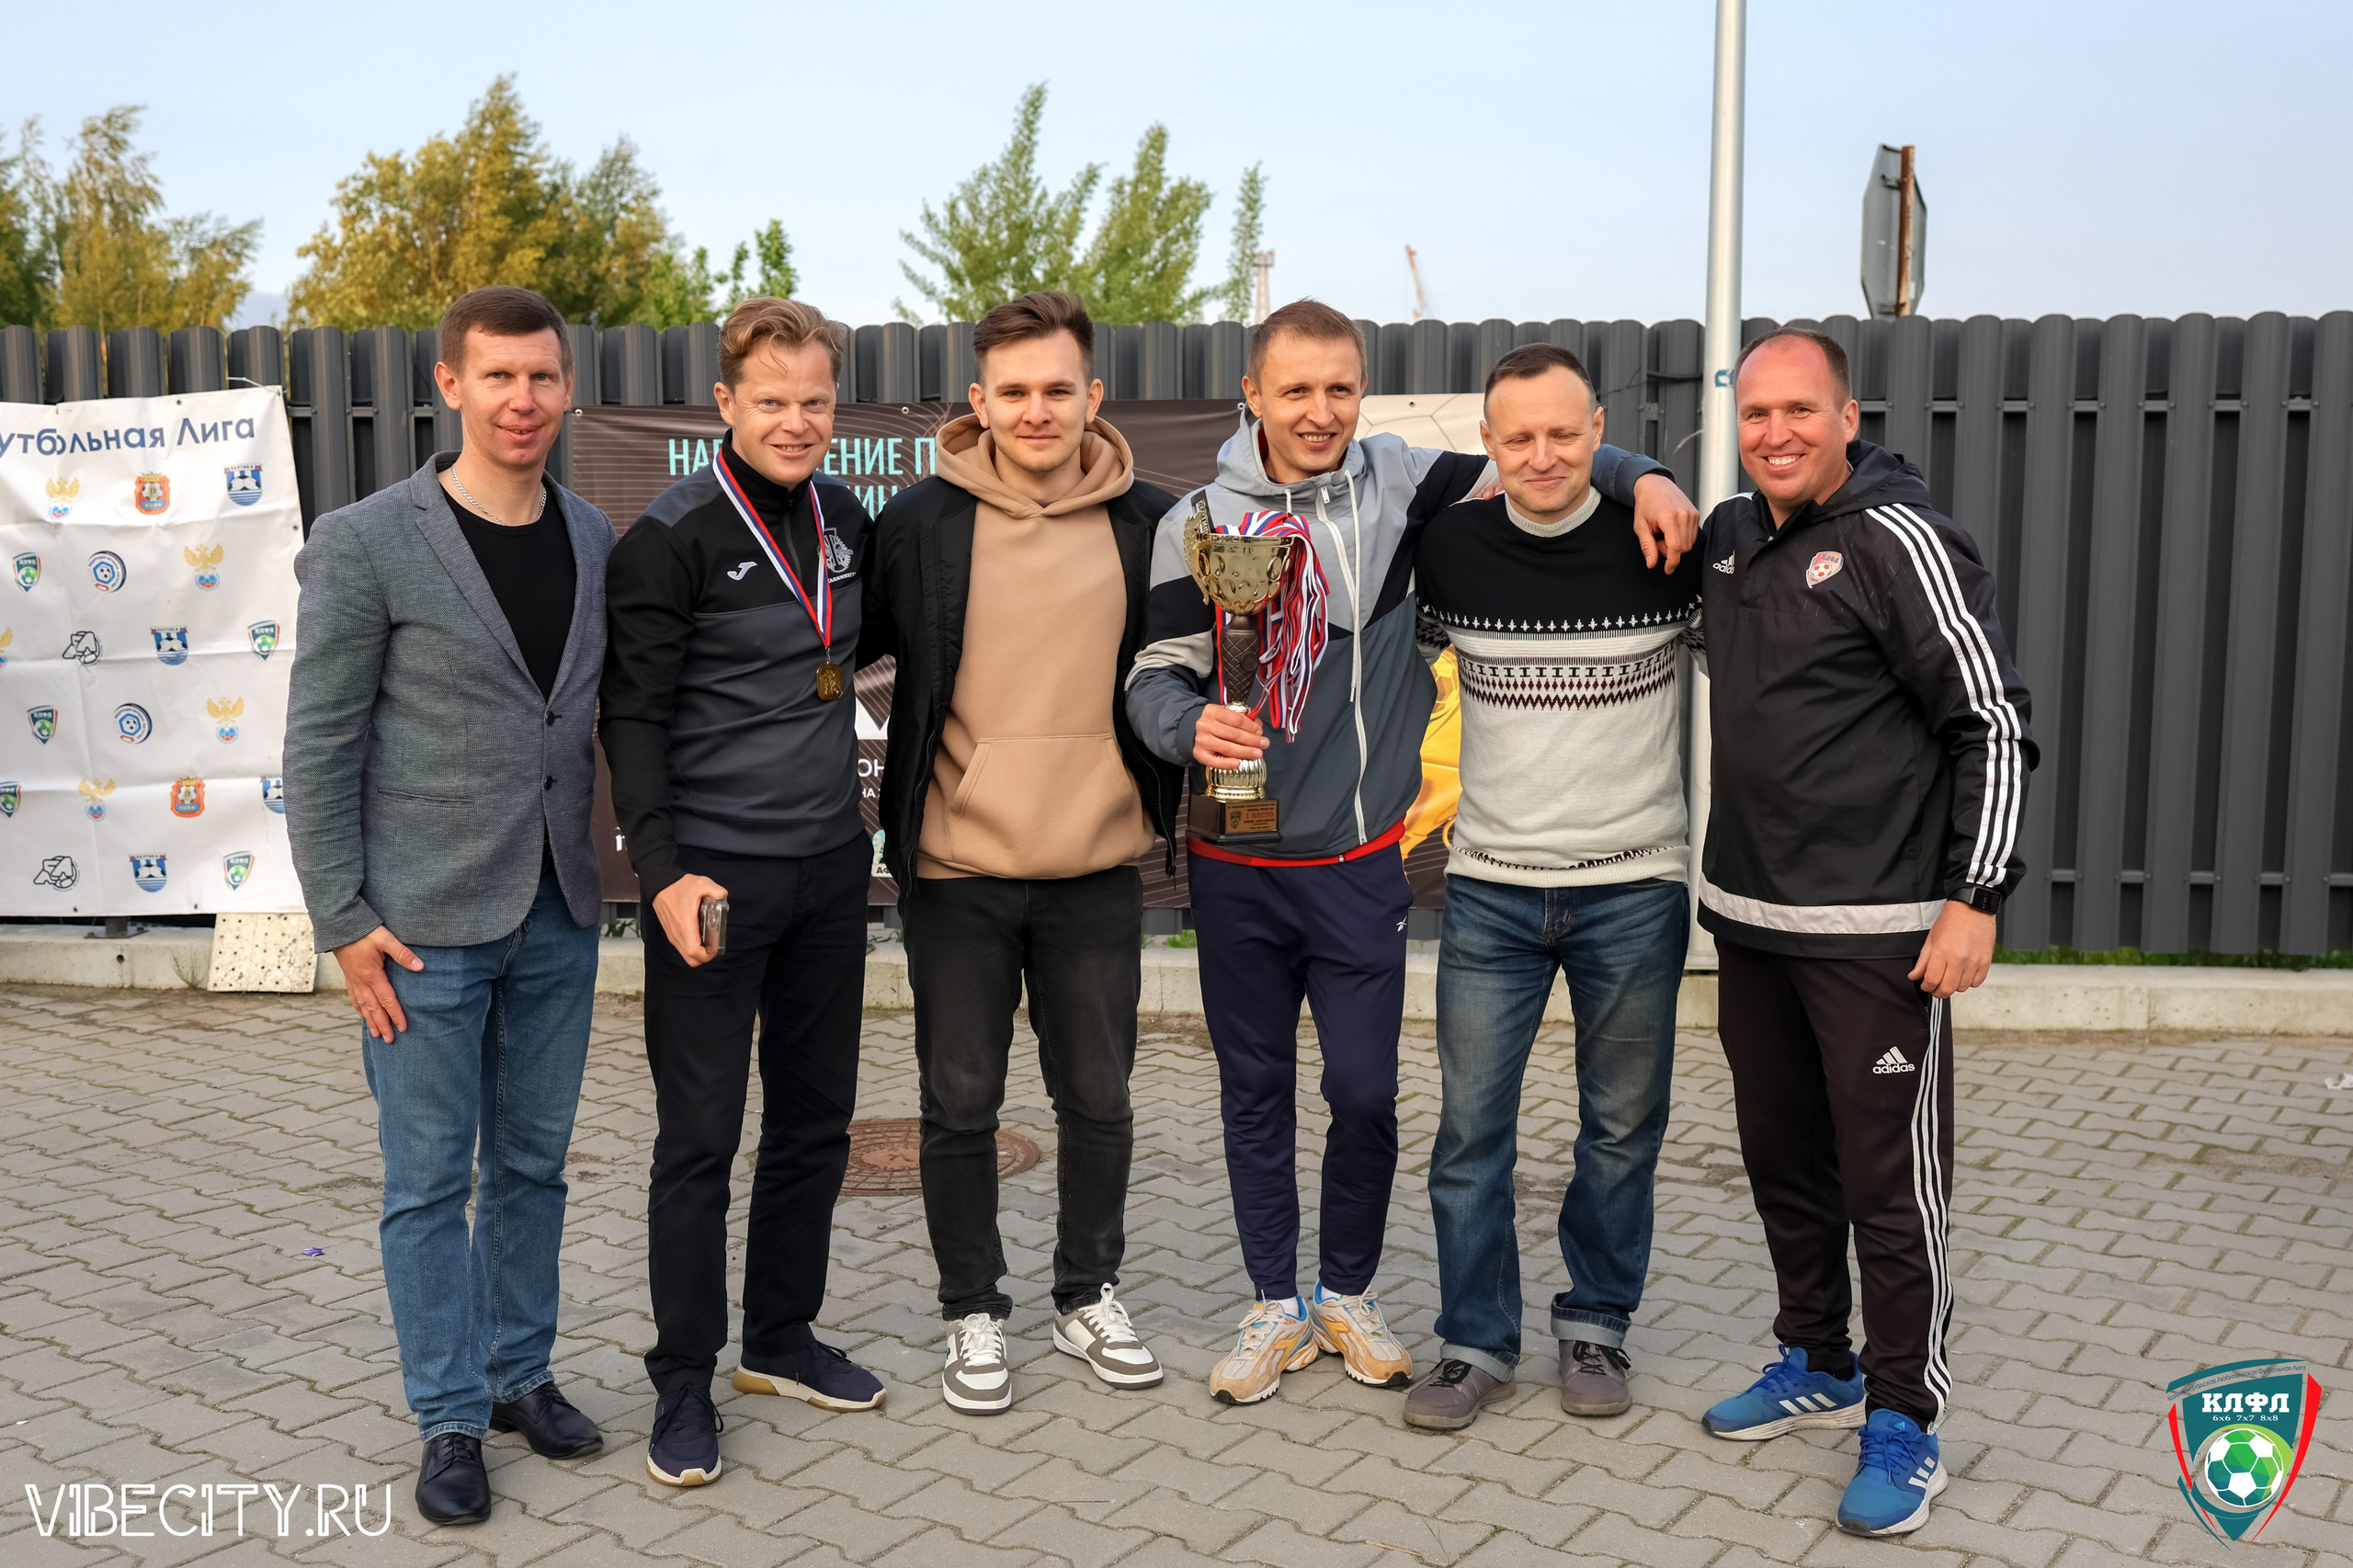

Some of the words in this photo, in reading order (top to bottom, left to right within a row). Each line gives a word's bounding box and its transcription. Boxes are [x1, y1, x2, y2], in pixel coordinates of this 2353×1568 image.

[0, 427, 165, 458] утбольная
[176, 417, 256, 446] Лига
[1872, 1063, 1915, 1074] adidas
